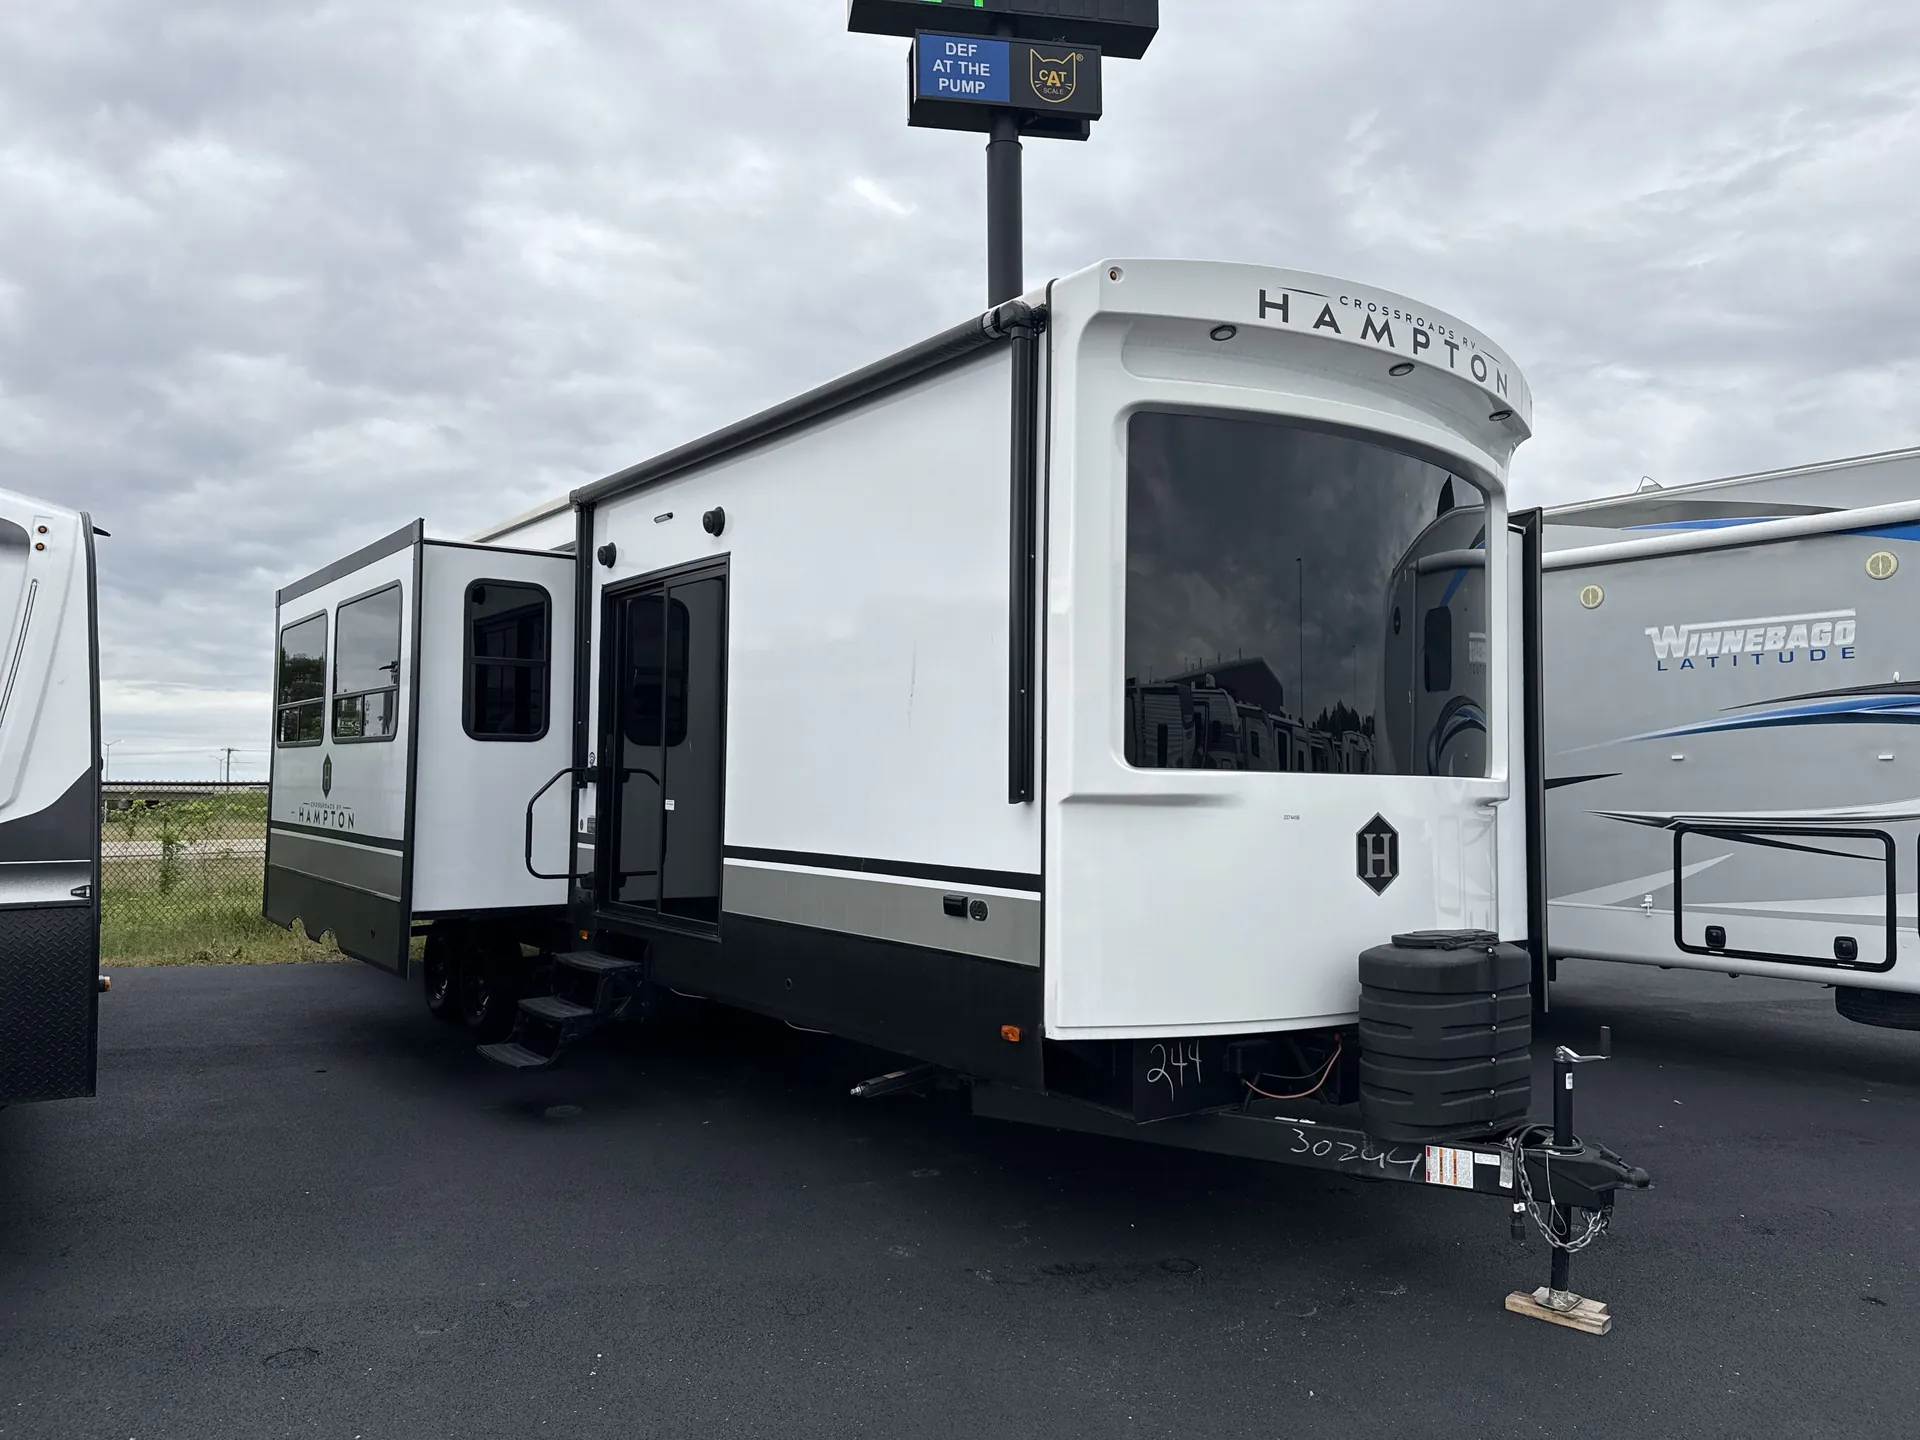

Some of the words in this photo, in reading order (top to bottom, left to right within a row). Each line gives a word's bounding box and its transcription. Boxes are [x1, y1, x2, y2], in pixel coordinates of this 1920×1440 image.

[945, 42, 977, 57] DEF
[933, 59, 954, 72] AT
[958, 61, 990, 77] THE
[1039, 70, 1067, 86] CAT
[939, 78, 985, 94] PUMP
[1043, 87, 1064, 95] SCALE
[1340, 295, 1455, 339] CROSSROADS
[1462, 337, 1476, 349] RV
[1258, 289, 1508, 397] HAMPTON
[1657, 647, 1855, 671] LATITUDE
[298, 807, 355, 829] HAMPTON
[1364, 833, 1392, 878] H
[1147, 1041, 1202, 1101] 244
[1289, 1127, 1423, 1180] 30244
